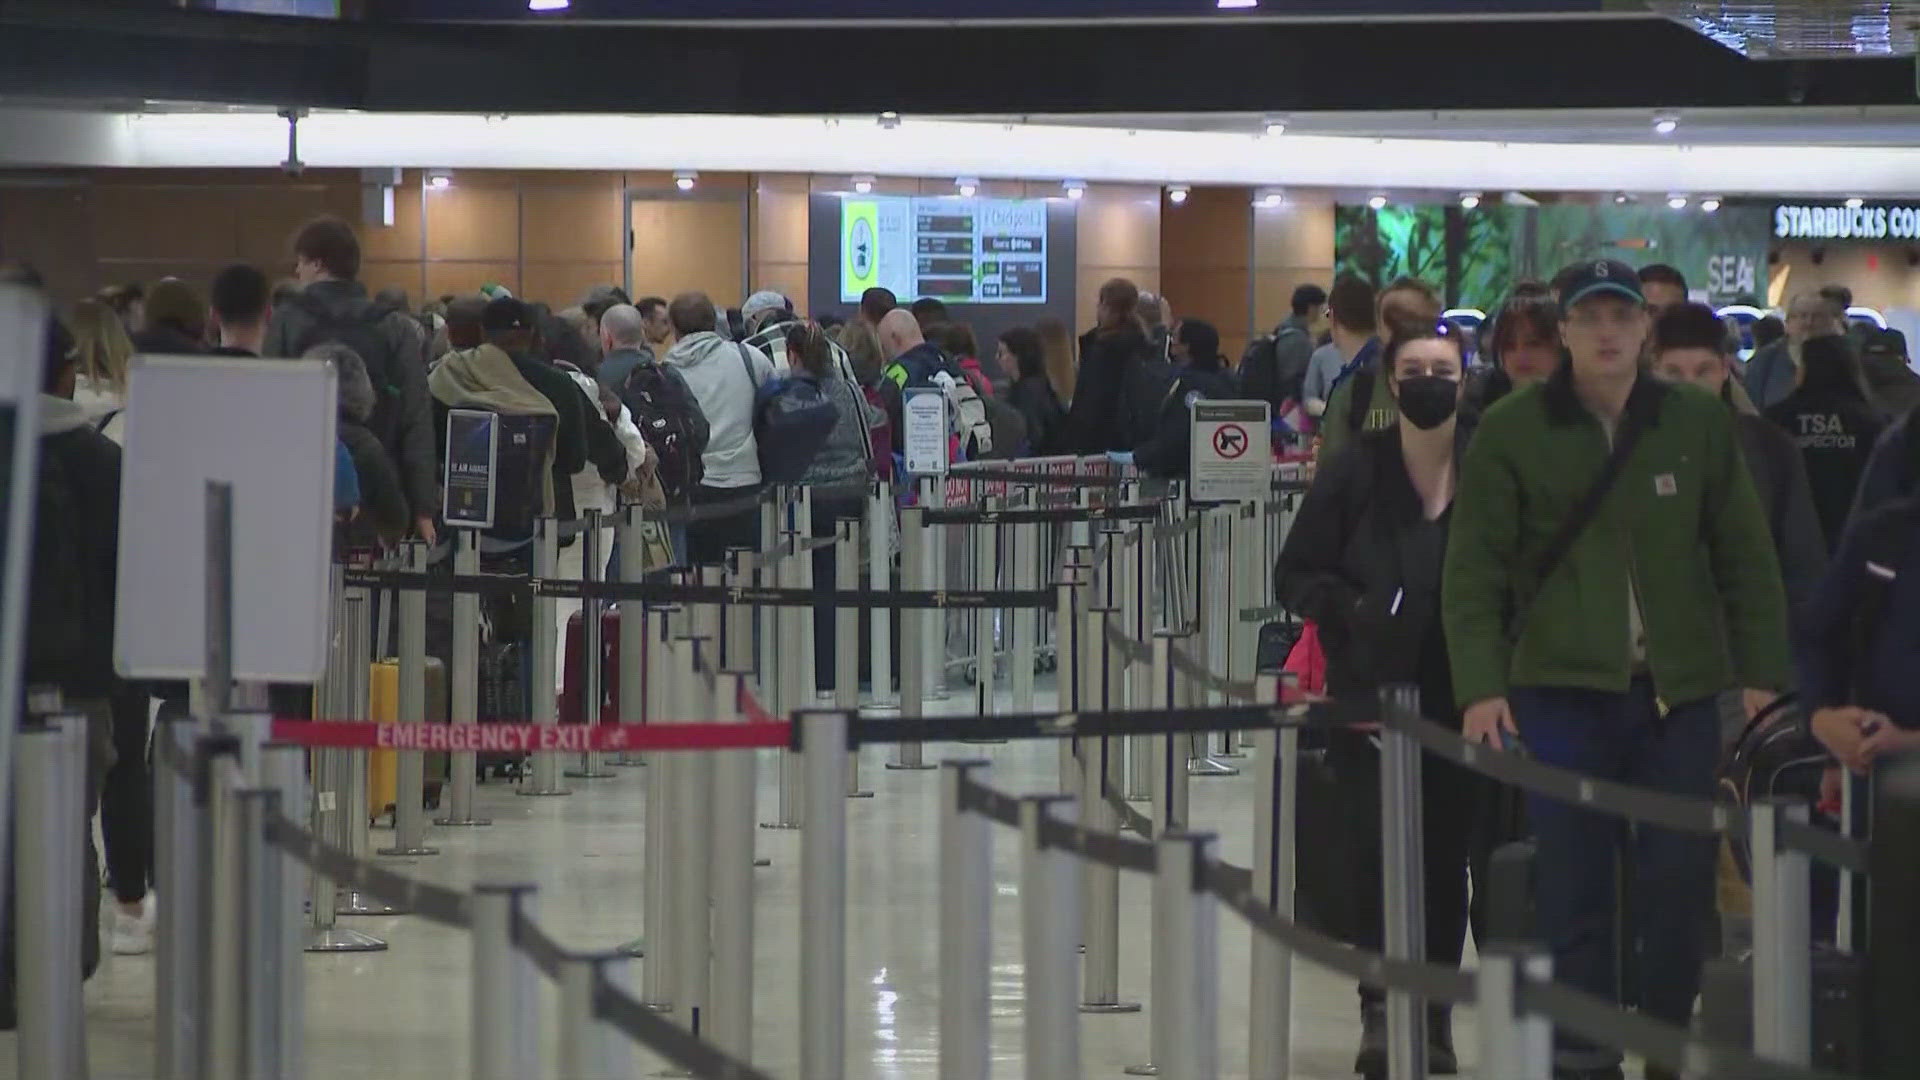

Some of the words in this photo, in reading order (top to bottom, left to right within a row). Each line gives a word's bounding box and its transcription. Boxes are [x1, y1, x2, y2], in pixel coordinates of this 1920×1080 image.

[1774, 205, 1887, 238] STARBUCKS
[1796, 413, 1843, 433] TSA
[377, 724, 531, 750] EMERGENCY
[540, 727, 592, 750] EXIT
